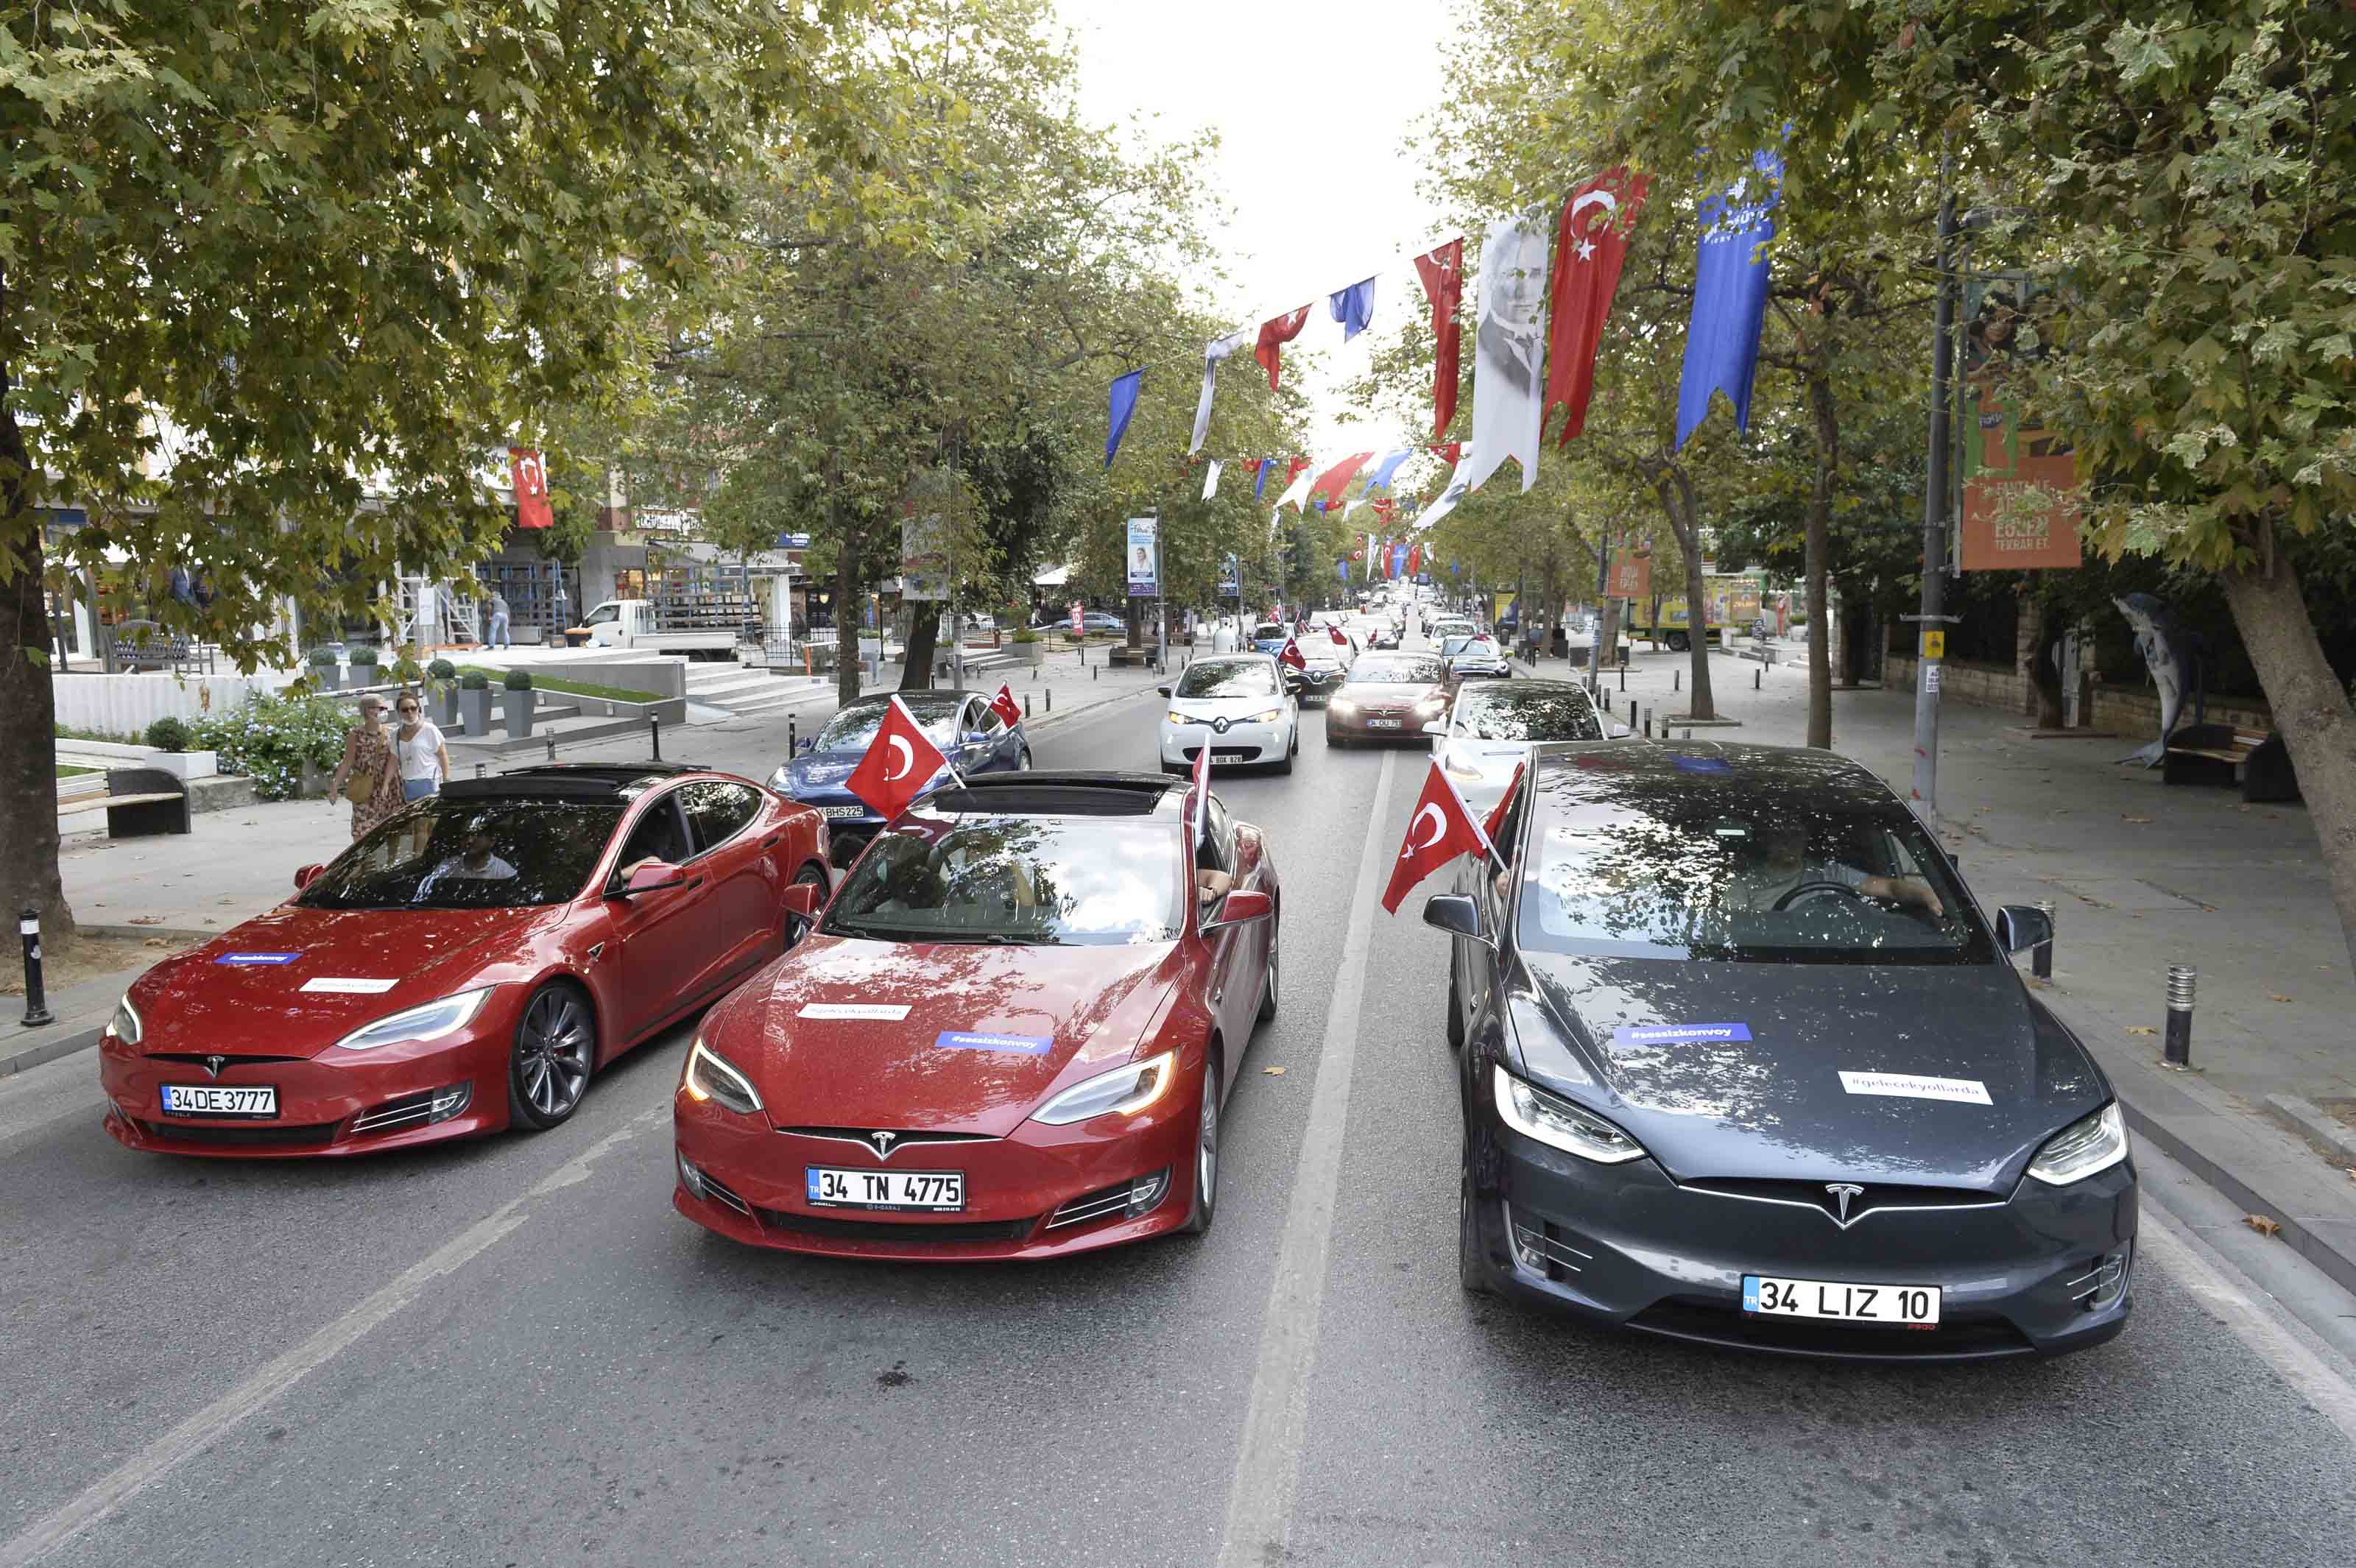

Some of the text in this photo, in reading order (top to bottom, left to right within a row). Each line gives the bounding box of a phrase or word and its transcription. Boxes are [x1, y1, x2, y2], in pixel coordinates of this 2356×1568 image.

[1852, 1078, 1979, 1095] #gelecekyollarda
[822, 1173, 847, 1198] 34
[863, 1176, 889, 1200] TN
[904, 1177, 959, 1202] 4775
[1760, 1282, 1799, 1313] 34
[1819, 1286, 1879, 1318] LIZ
[1898, 1290, 1929, 1319] 10
